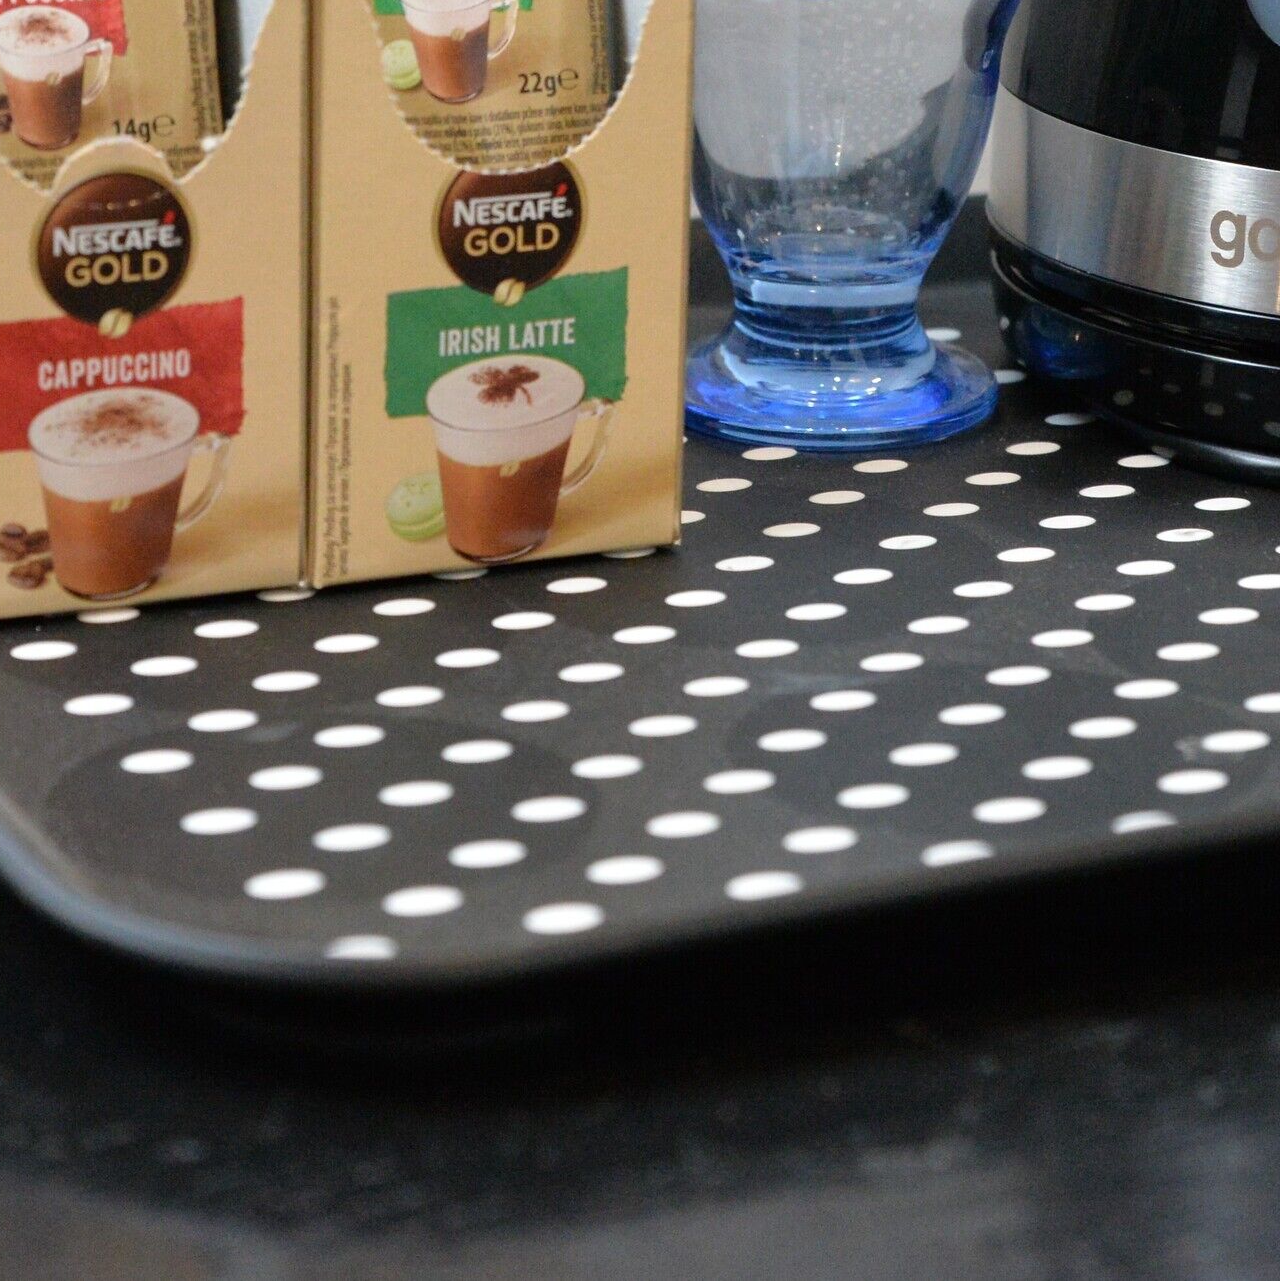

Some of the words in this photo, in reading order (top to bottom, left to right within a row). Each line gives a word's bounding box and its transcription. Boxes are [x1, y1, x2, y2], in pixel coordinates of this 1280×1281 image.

[464, 221, 559, 258] GOLD
[63, 251, 169, 289] GOLD
[439, 327, 500, 357] IRISH
[508, 318, 576, 351] LATTE
[37, 349, 191, 391] CAPPUCCINO
